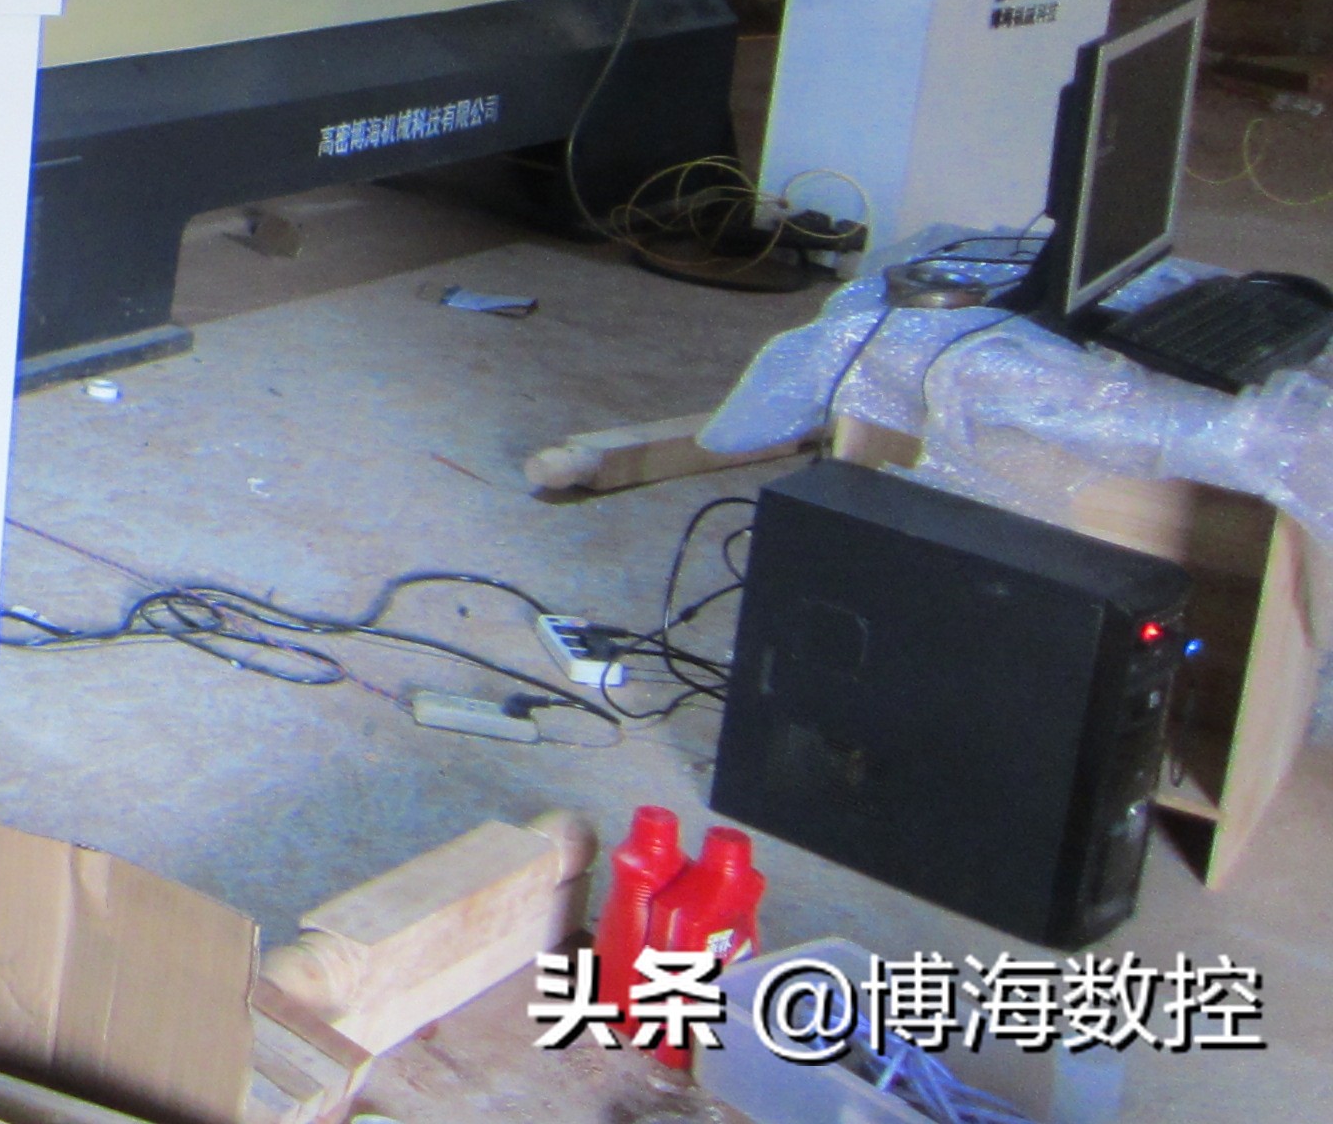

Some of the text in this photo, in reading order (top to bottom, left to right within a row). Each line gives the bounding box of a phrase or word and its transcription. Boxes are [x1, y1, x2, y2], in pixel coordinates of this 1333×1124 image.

[317, 93, 501, 158] 高密博海机械科技有限公司
